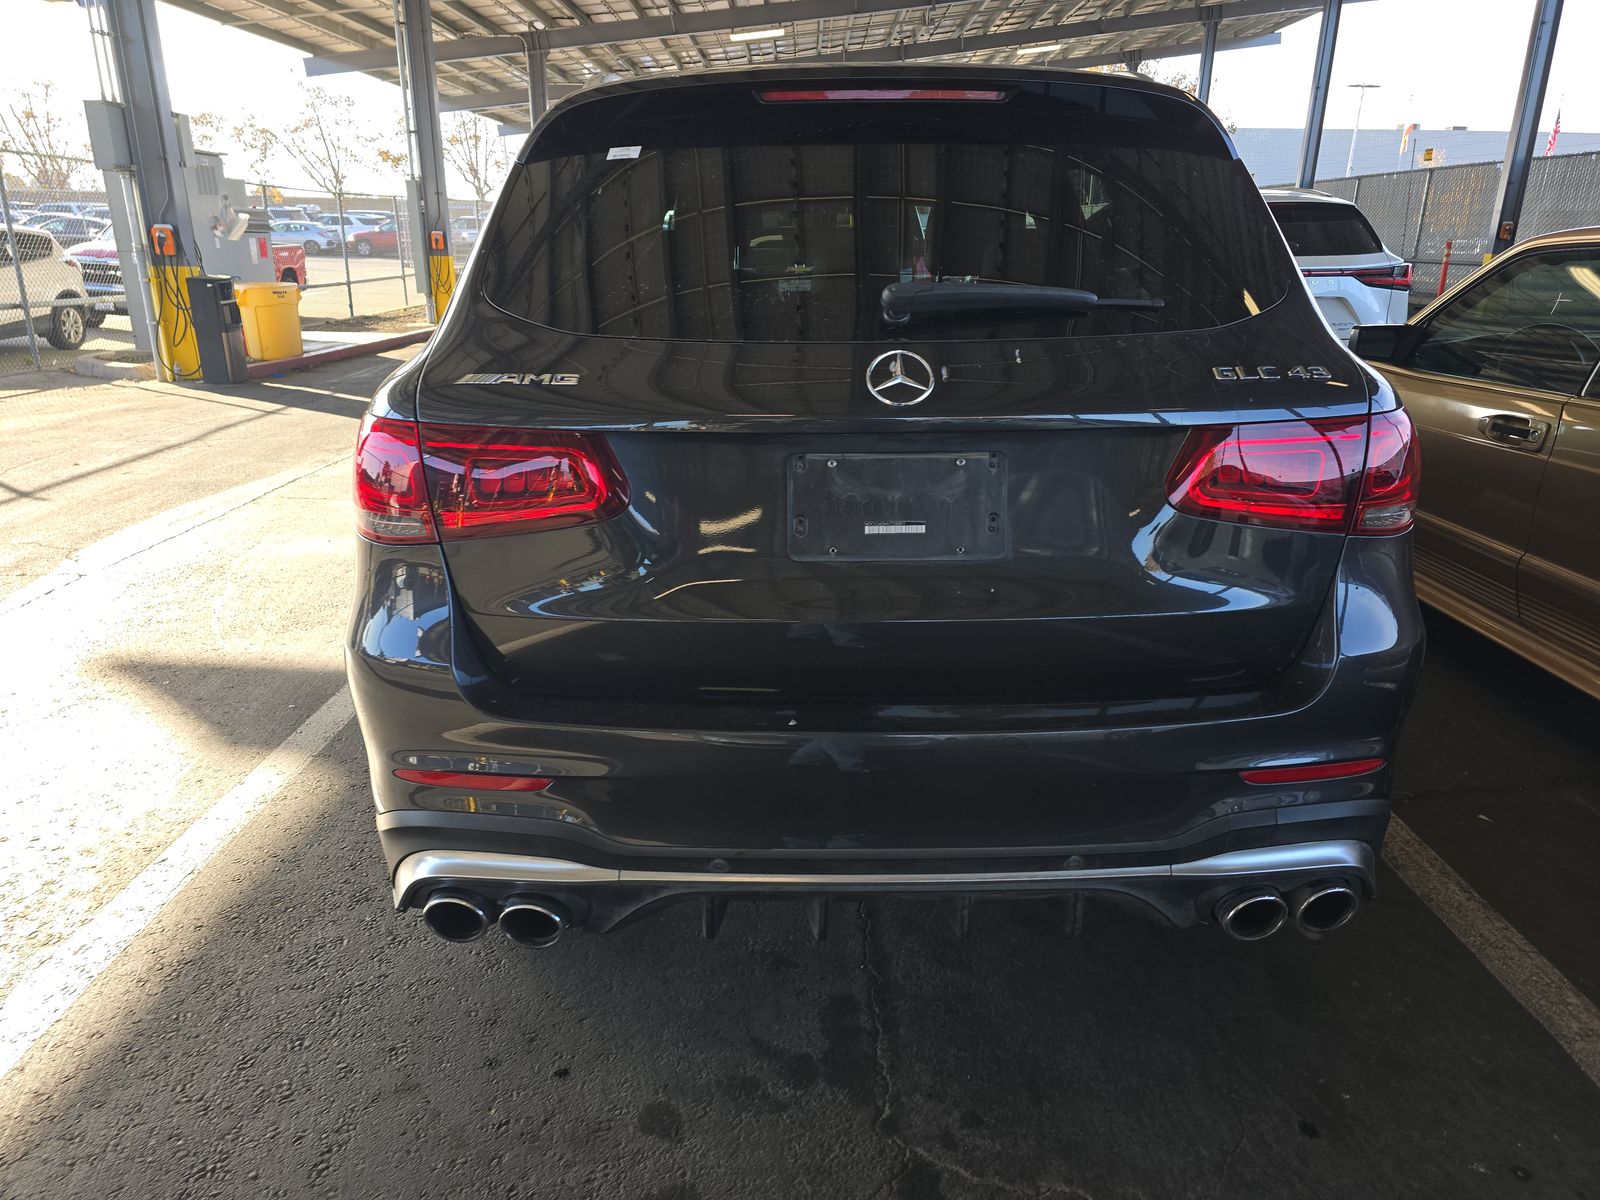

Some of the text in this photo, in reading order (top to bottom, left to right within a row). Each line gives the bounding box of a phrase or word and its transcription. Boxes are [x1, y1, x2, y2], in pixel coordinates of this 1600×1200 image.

[494, 373, 580, 385] AMG
[1212, 366, 1332, 380] GLC 43
